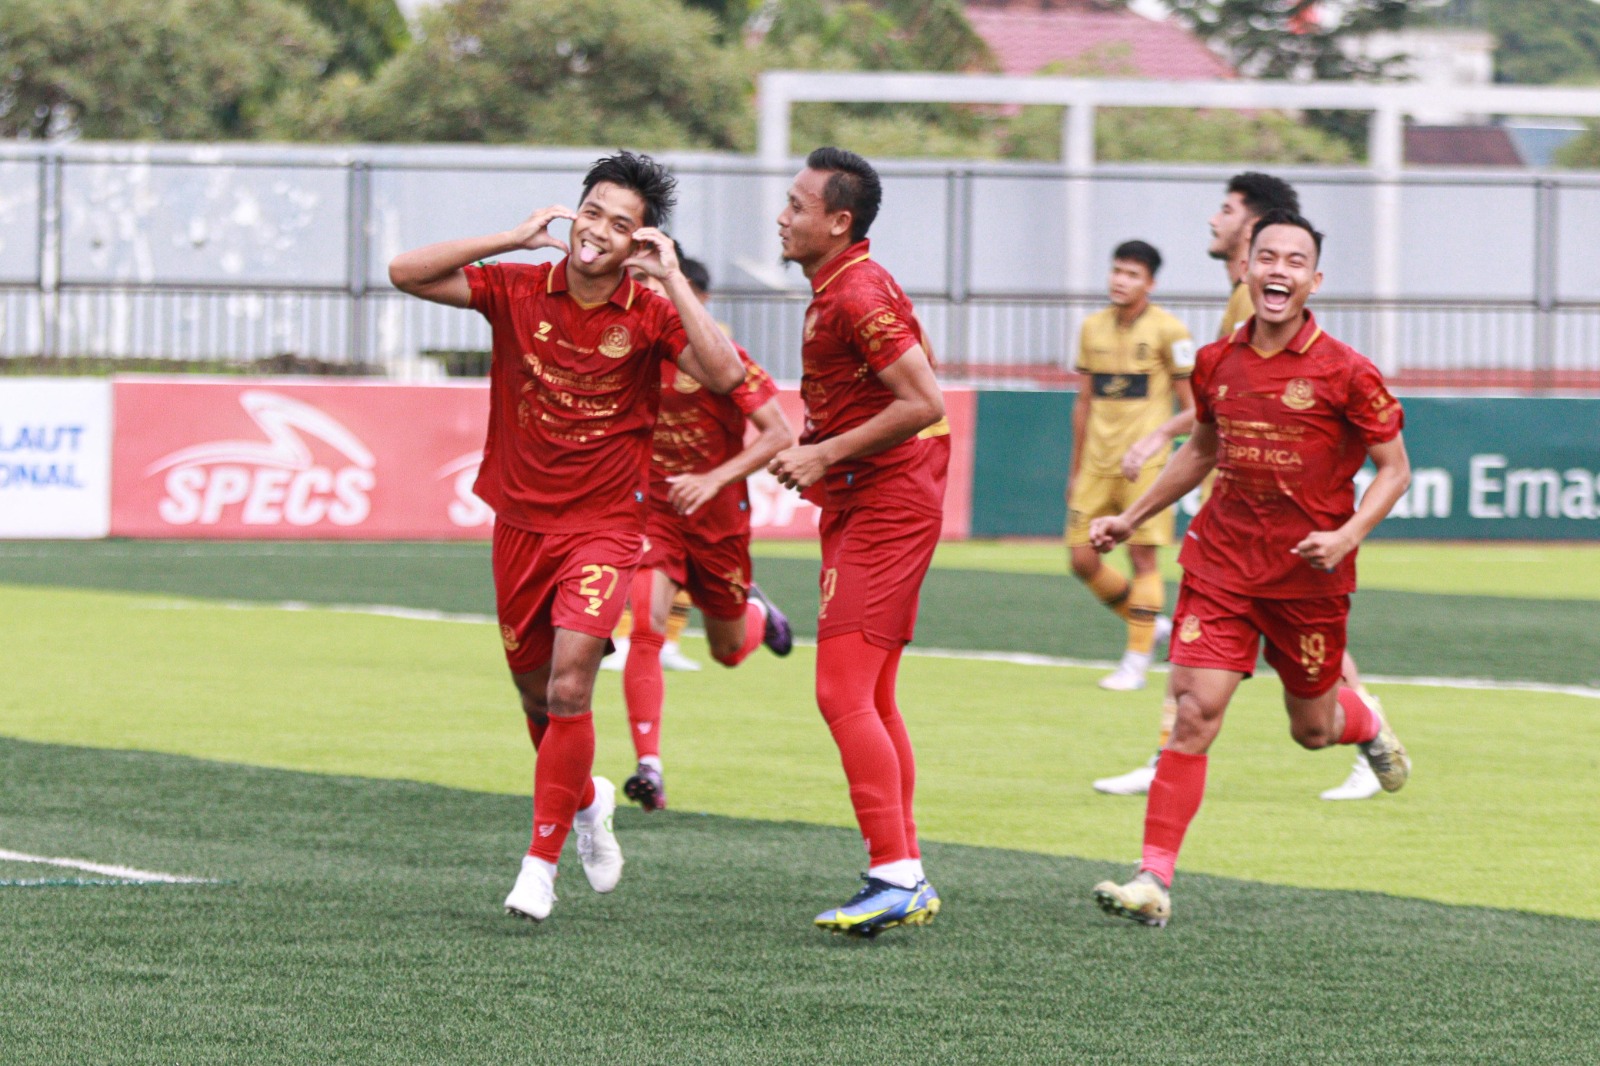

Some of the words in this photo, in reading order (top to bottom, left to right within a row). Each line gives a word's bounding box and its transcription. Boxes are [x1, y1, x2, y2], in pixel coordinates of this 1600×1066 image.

[1227, 444, 1261, 462] BPR
[1264, 449, 1303, 466] KCA
[157, 465, 377, 527] SPECS
[1469, 453, 1600, 520] Ema
[579, 564, 619, 600] 27
